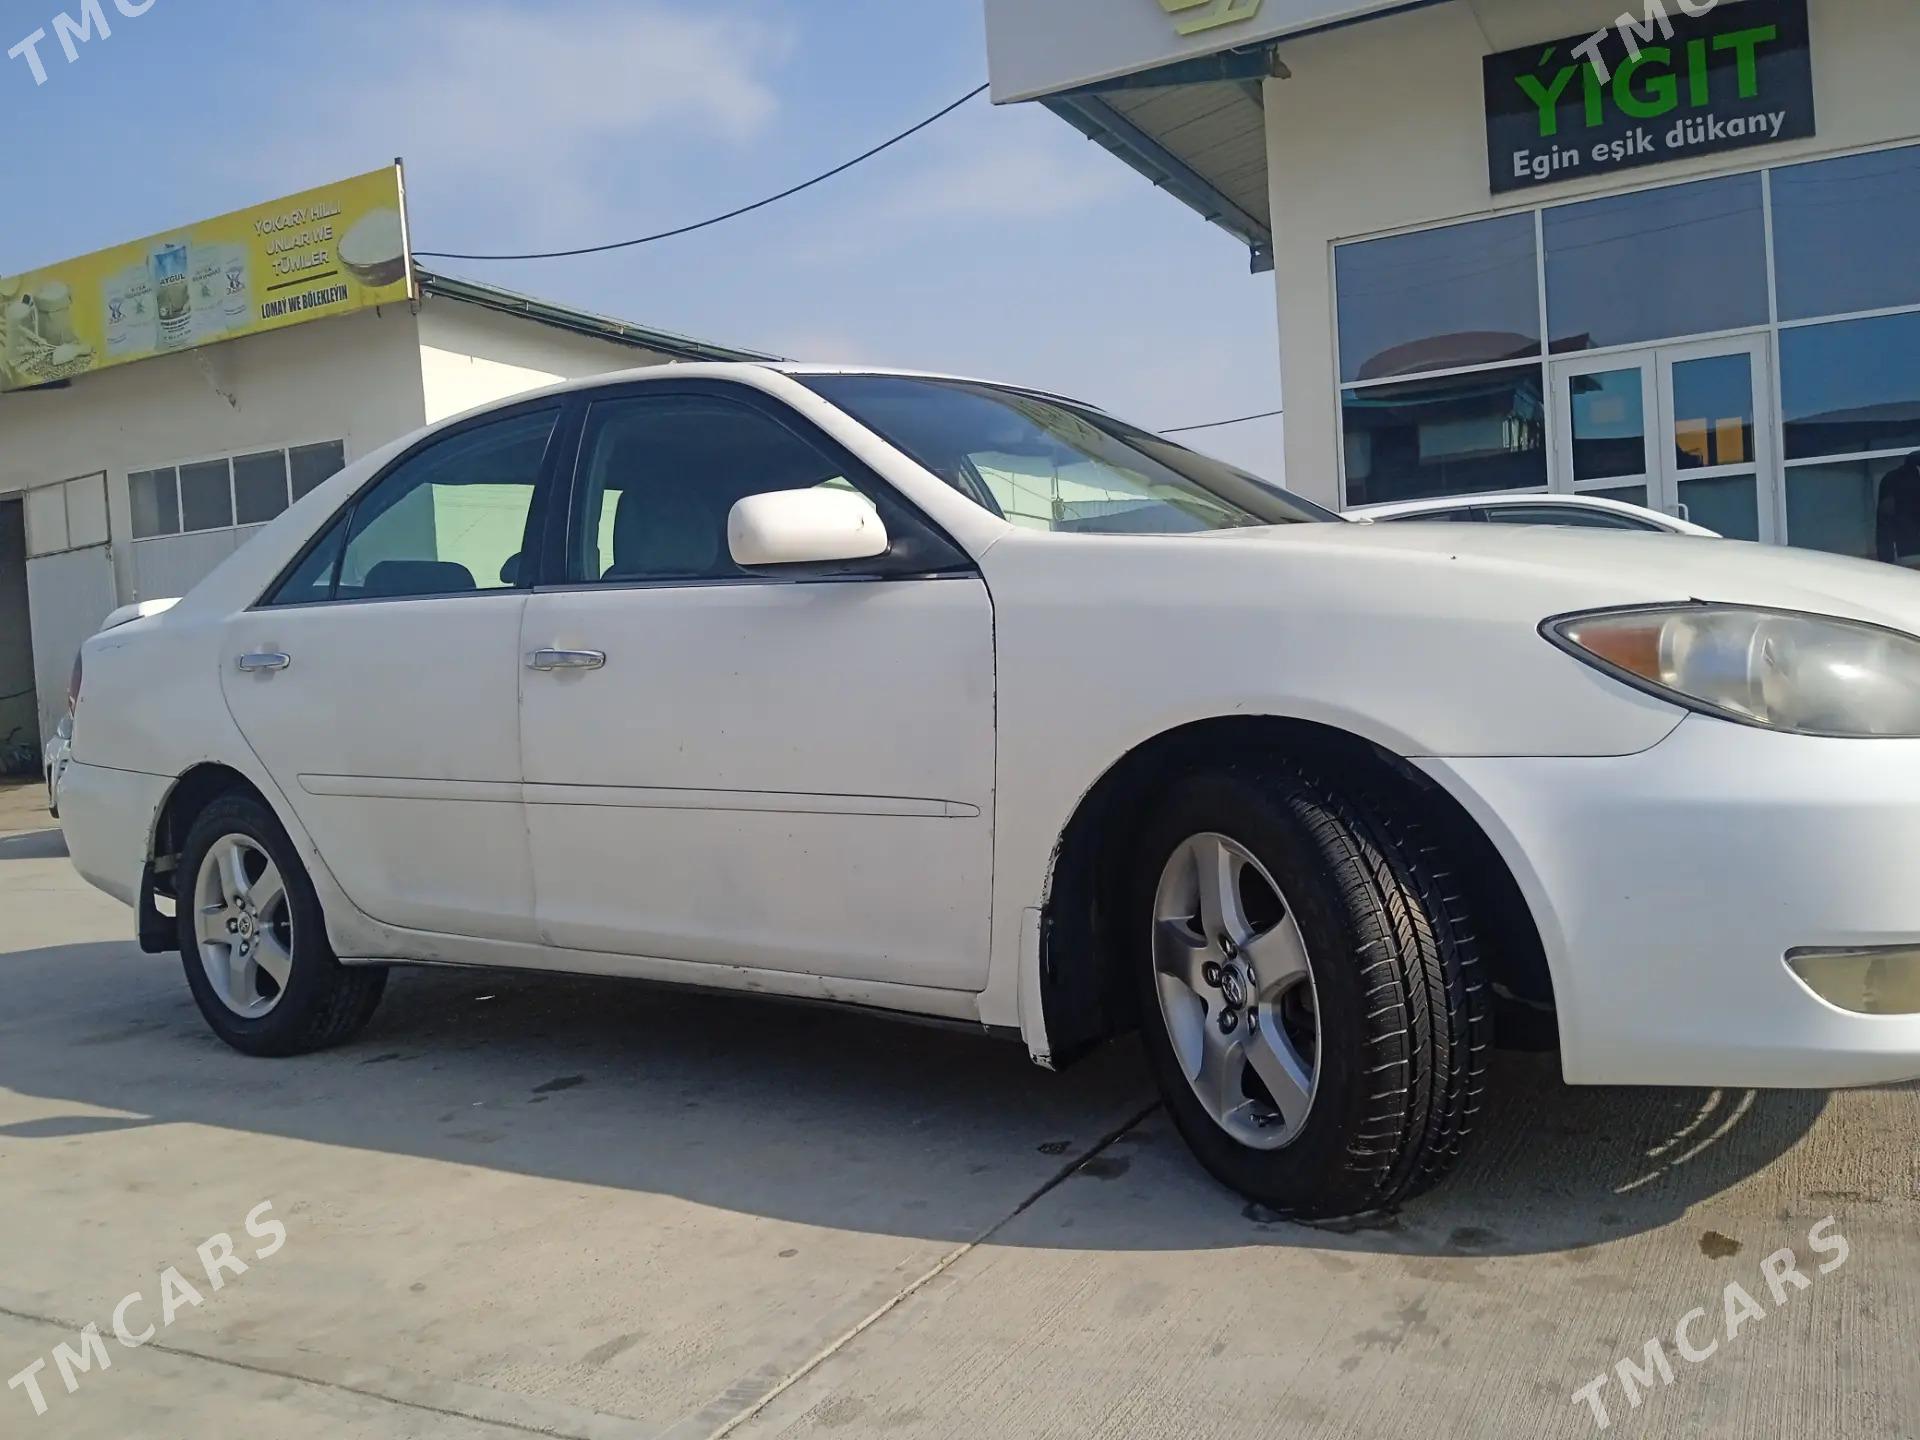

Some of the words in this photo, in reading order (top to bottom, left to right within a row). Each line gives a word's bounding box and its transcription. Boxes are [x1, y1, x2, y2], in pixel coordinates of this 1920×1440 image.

[1514, 24, 1776, 137] ÝIGIT
[1513, 145, 1579, 180] Egin
[1592, 127, 1655, 162] eşik
[1665, 110, 1786, 148] dükany
[266, 232, 311, 256] UNLAR
[313, 226, 333, 244] WE
[289, 294, 303, 312] WE
